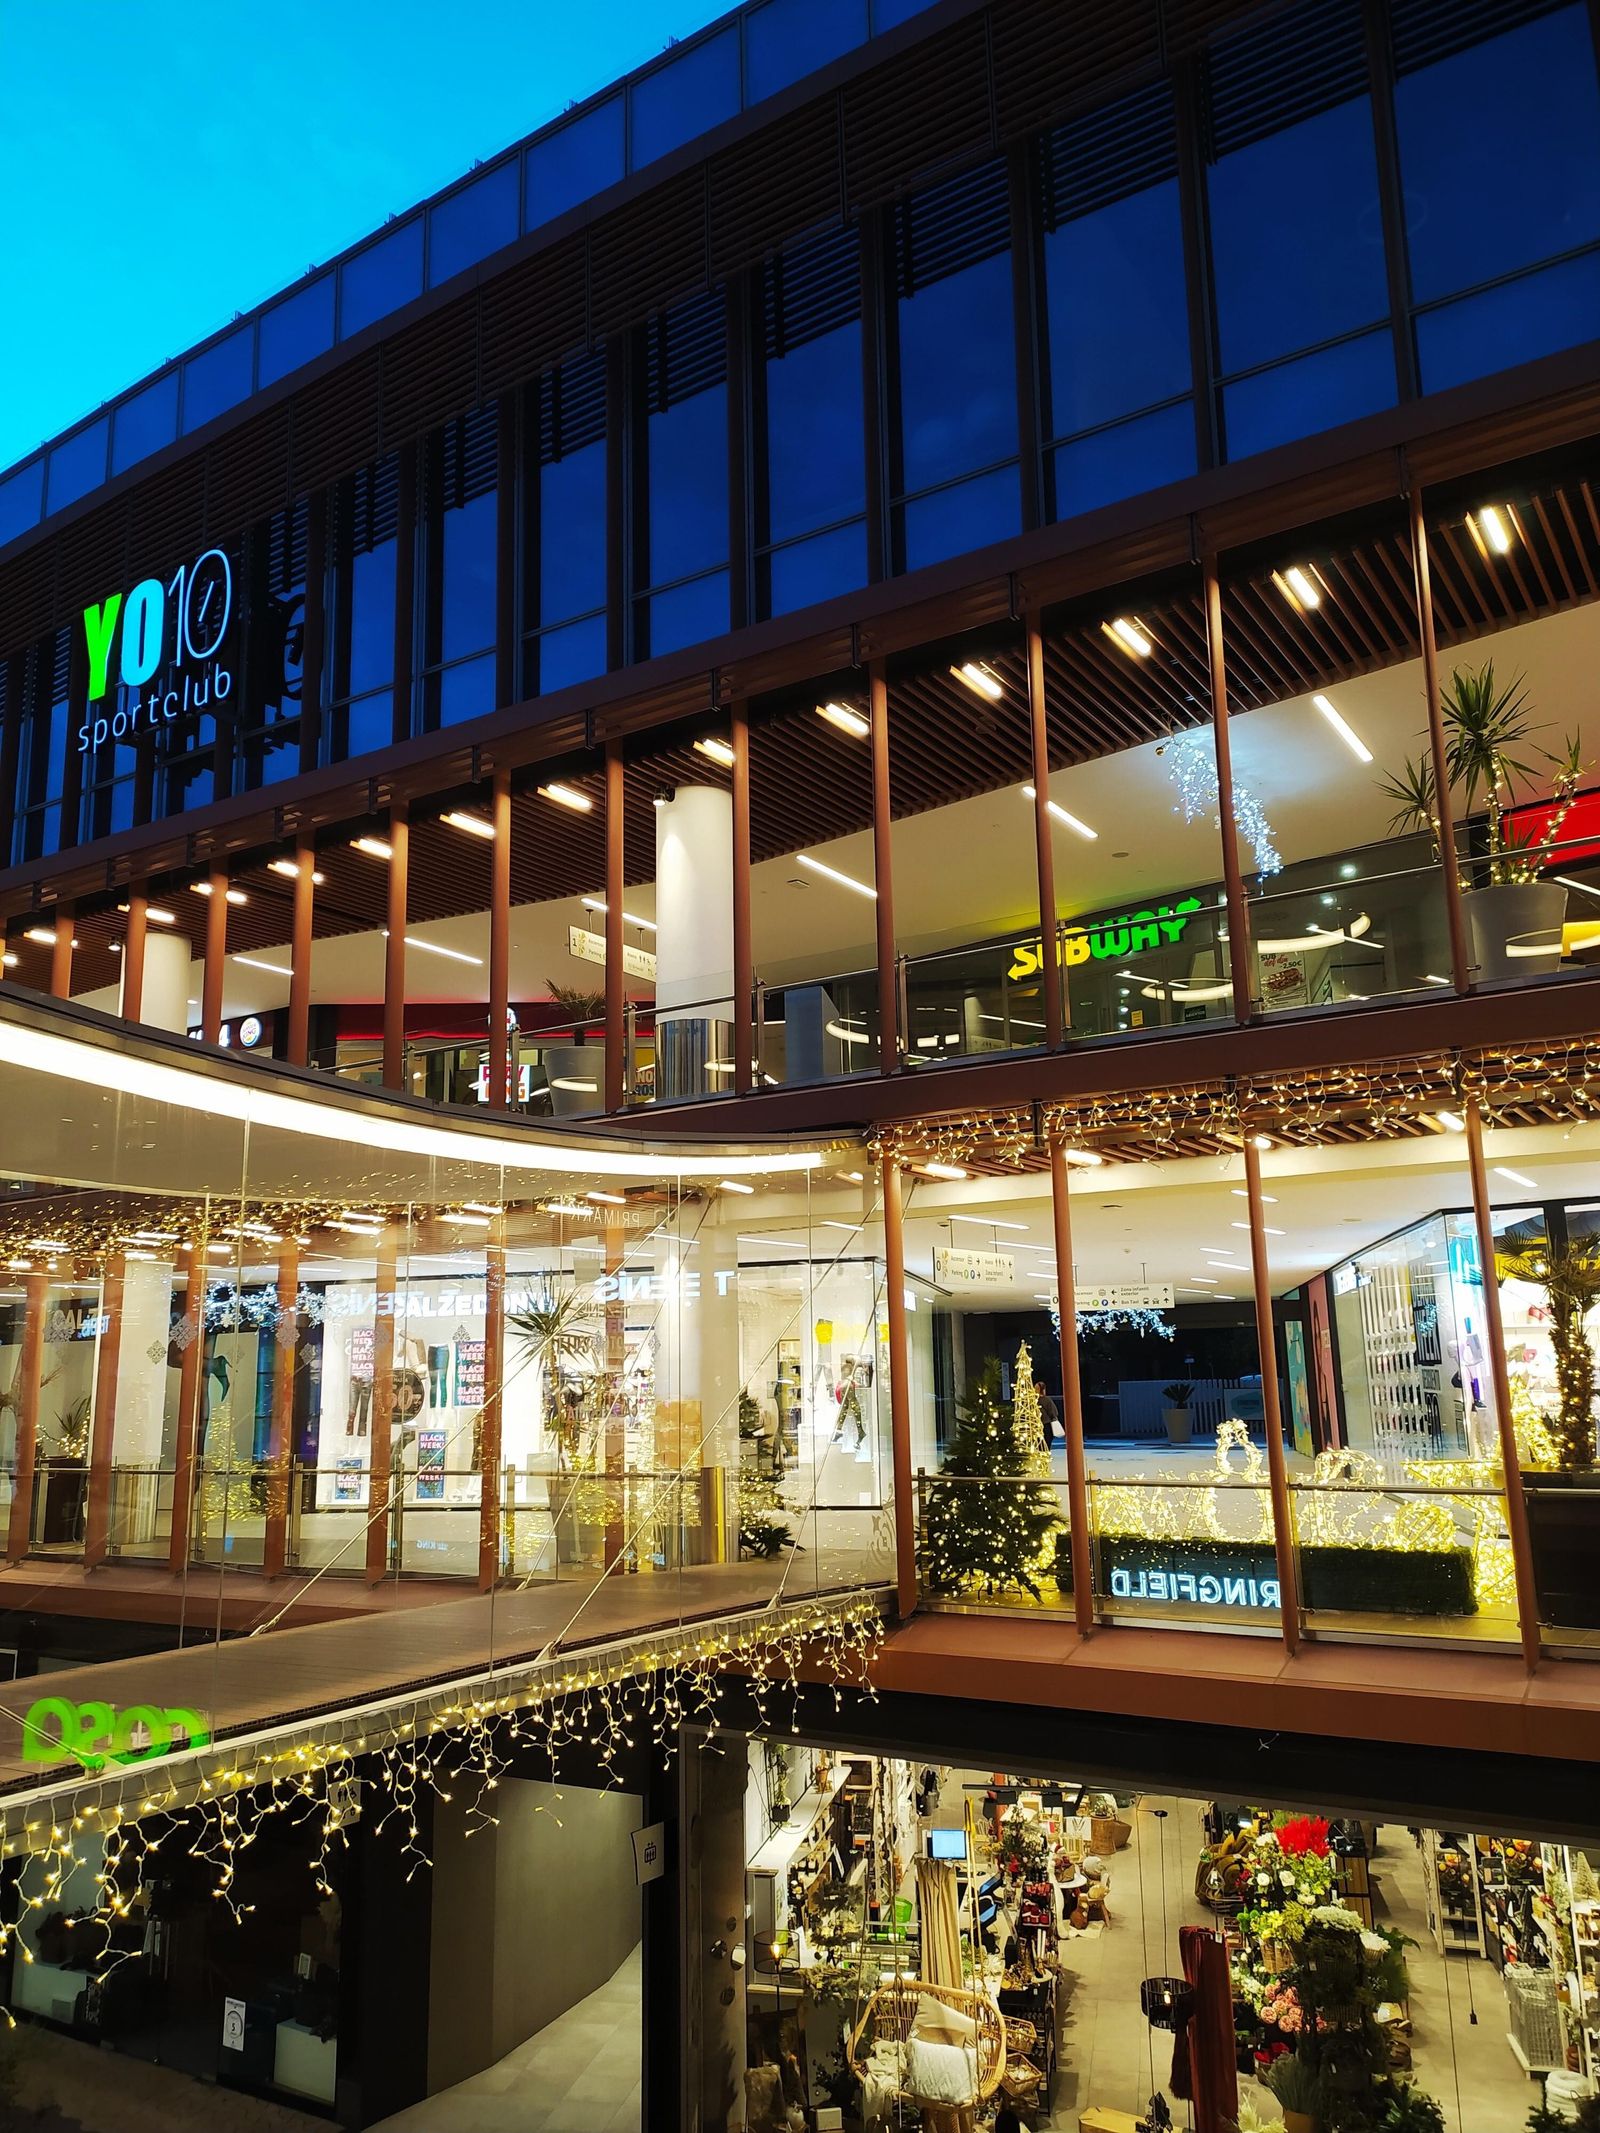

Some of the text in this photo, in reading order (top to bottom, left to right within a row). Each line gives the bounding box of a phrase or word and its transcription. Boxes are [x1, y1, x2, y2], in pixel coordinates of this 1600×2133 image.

[77, 667, 232, 753] sportclub
[420, 1434, 445, 1442] BLACK
[420, 1441, 446, 1449] WEEK!
